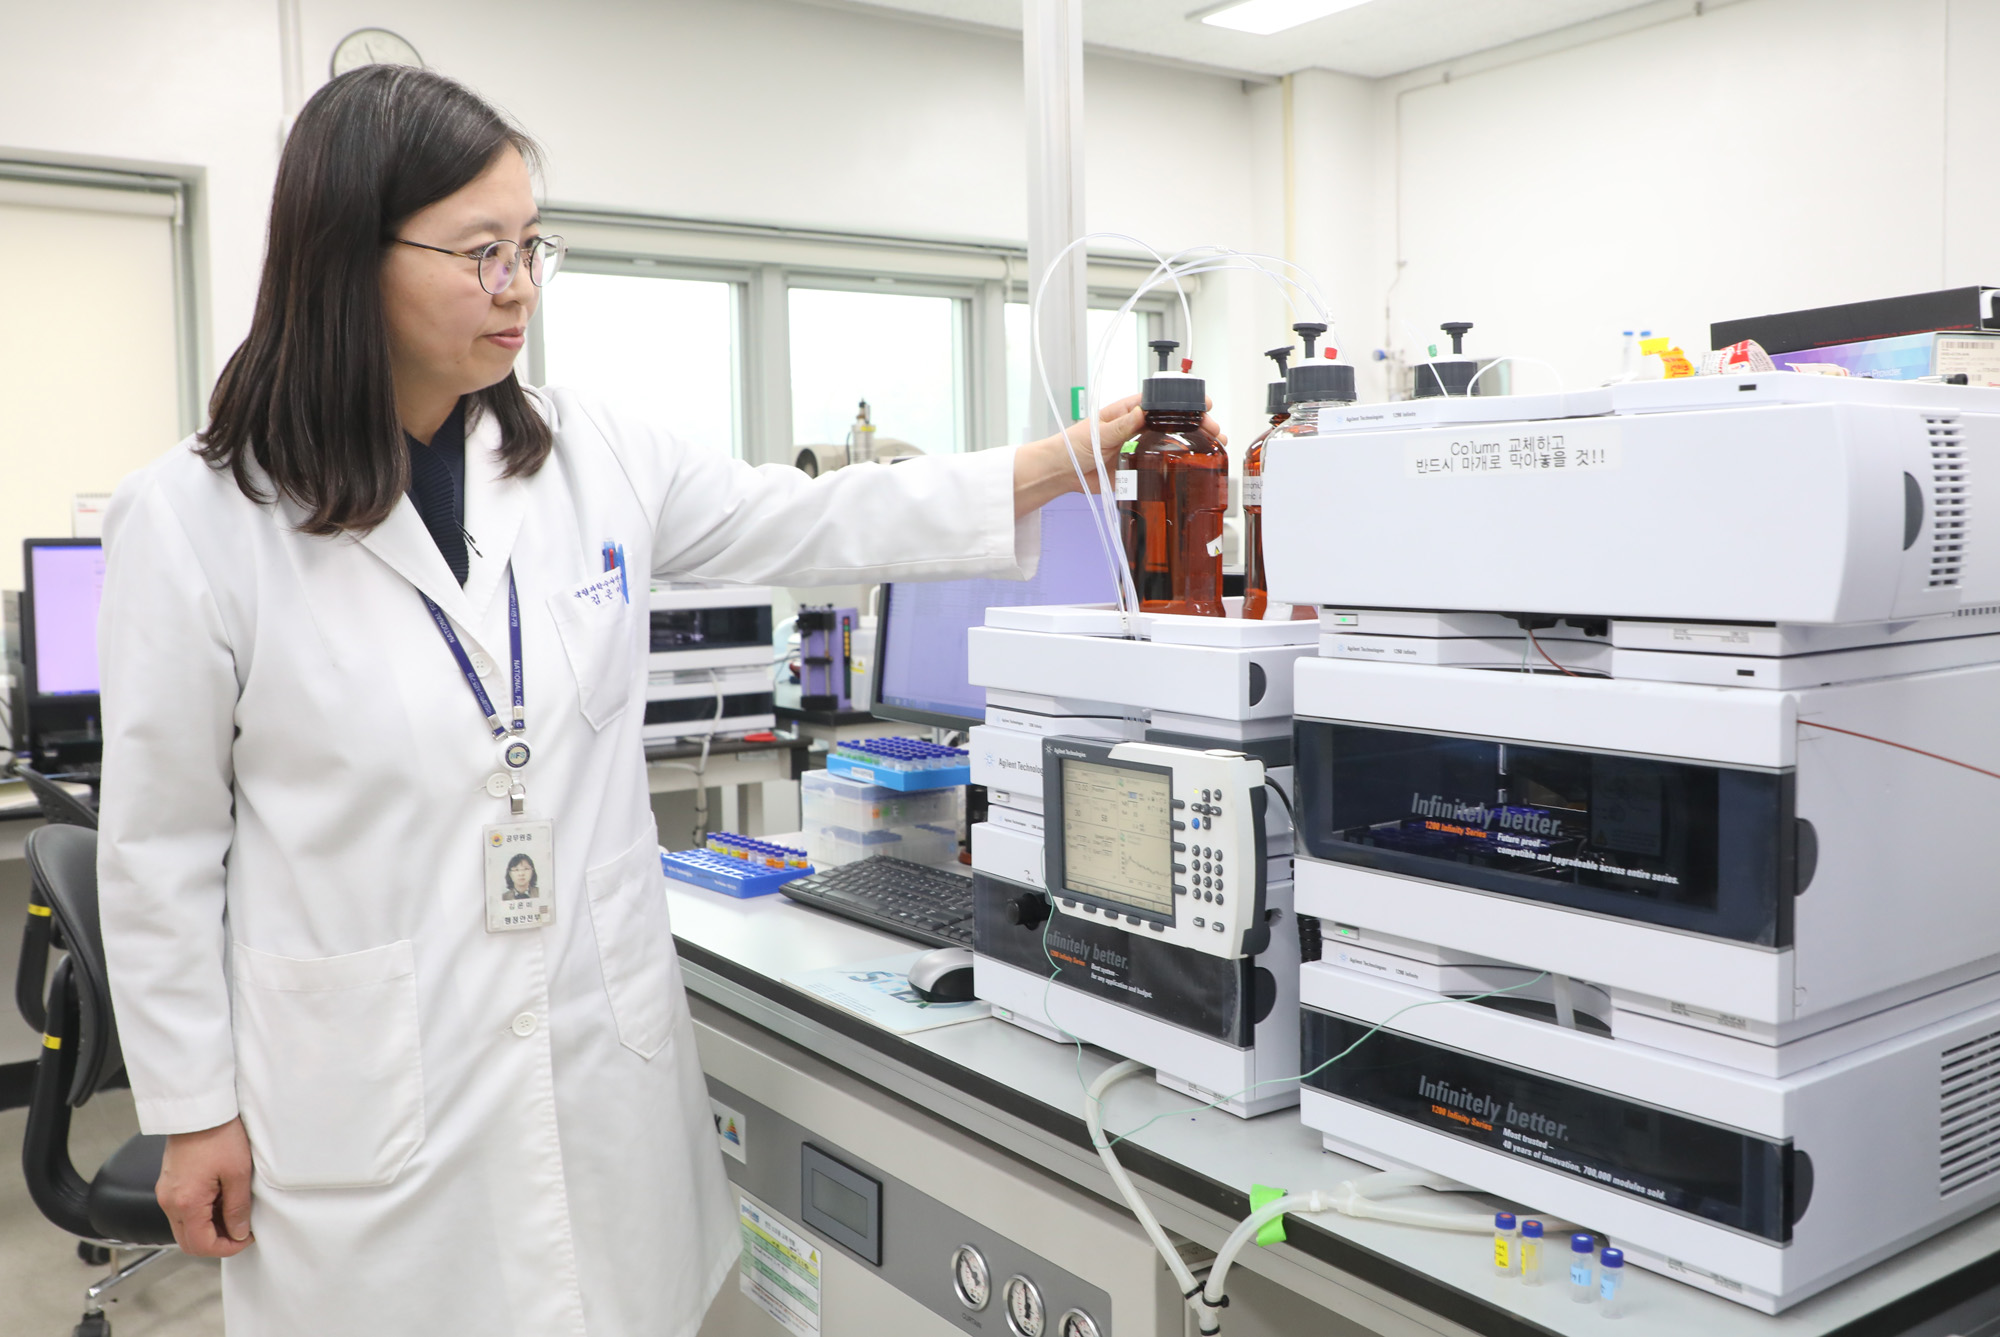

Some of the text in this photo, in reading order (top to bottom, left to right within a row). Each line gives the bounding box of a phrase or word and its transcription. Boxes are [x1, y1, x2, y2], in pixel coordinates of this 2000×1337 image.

[1450, 435, 1565, 456] Column 교체하고
[1416, 449, 1605, 474] 반드시 마개로 막아놓을 것!!
[435, 612, 455, 643] NATIONAL
[513, 659, 523, 695] NATIONAL
[998, 758, 1017, 769] Agilent
[1054, 747, 1087, 758] Agilent Technologies
[1411, 792, 1564, 837] Infinitely better.
[1425, 820, 1487, 838] 1200 Infinity Series
[1497, 832, 1520, 844] Future
[1520, 837, 1541, 847] proof
[1496, 846, 1680, 885] compatible and upgradeable across entire series.
[1046, 930, 1129, 970] nfinitely better.
[1105, 978, 1128, 990] application
[1418, 1074, 1569, 1142] Infinitely better.
[1431, 1104, 1493, 1131] 1200 Infinity Series
[1502, 1127, 1521, 1141] Most
[1522, 1134, 1548, 1150] trusted
[1502, 1139, 1667, 1201] 40 years of innovation, 700,000 modules sold.
